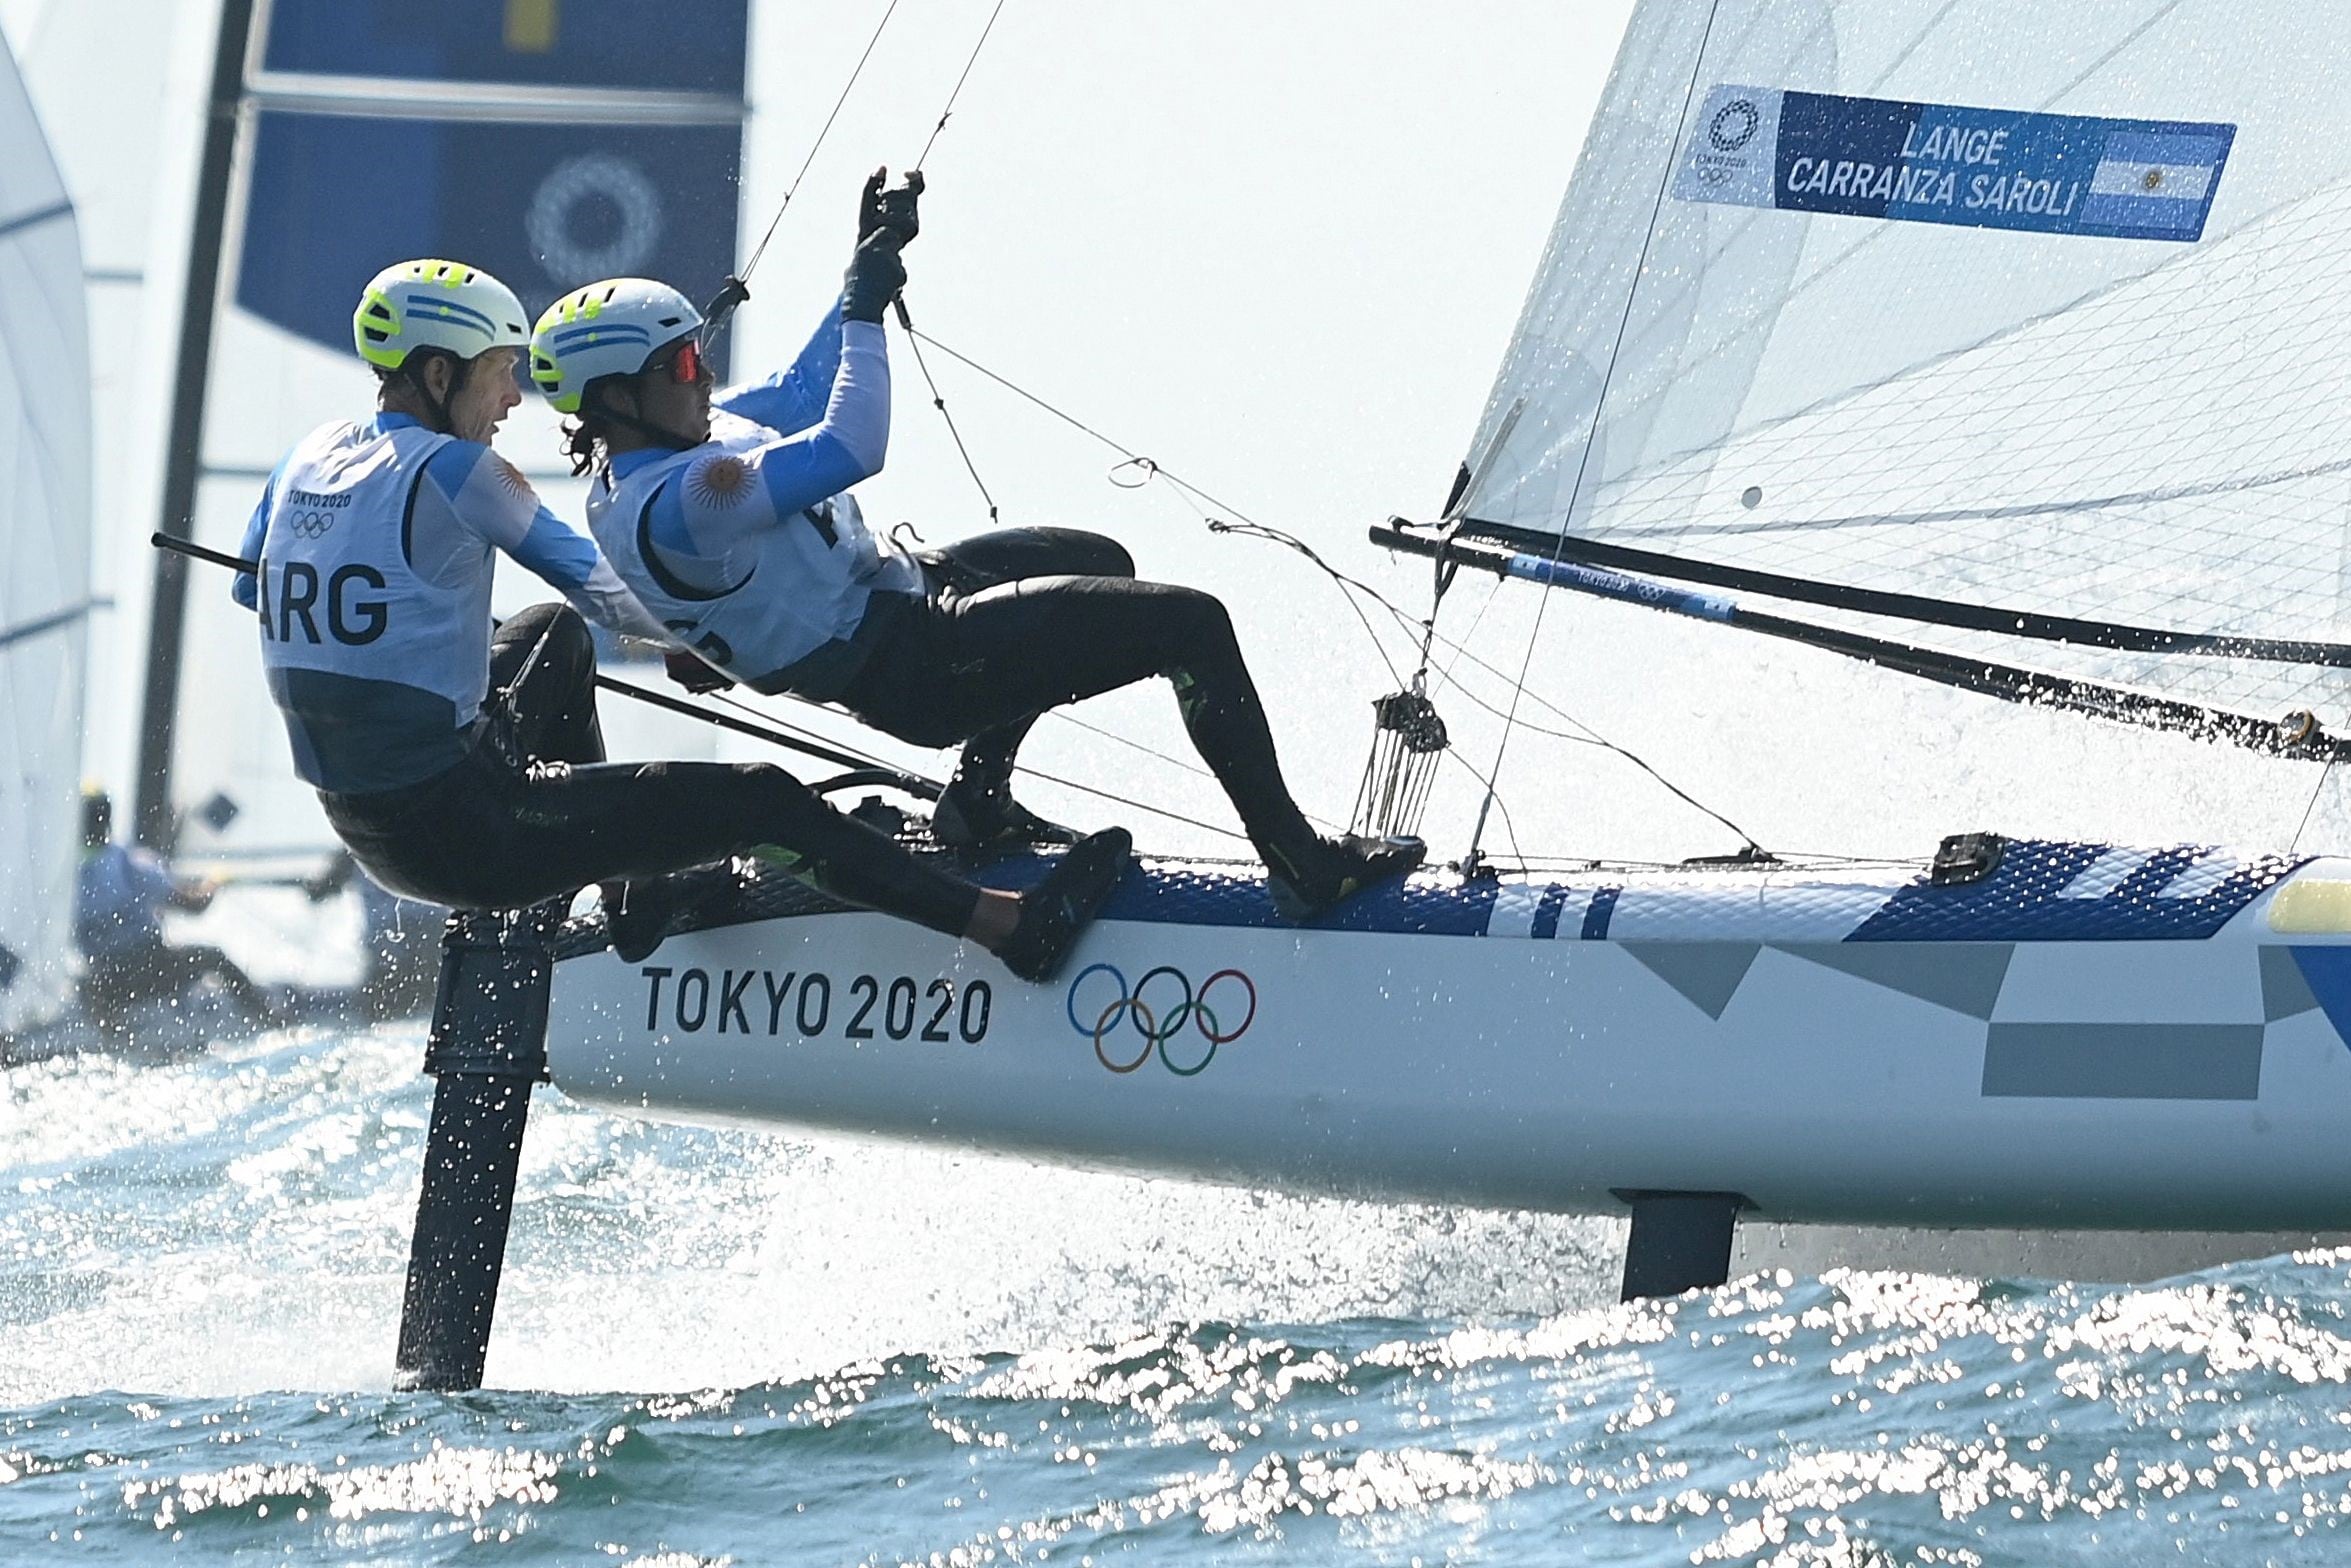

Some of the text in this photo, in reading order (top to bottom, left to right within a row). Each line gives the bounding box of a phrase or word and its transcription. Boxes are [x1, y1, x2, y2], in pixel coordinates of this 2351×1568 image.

[1901, 121, 2008, 166] LANGE
[1787, 157, 2079, 217] CARRANZA SAROLI
[288, 489, 352, 509] TOKYO 2020
[642, 967, 992, 1044] TOKYO 2020
